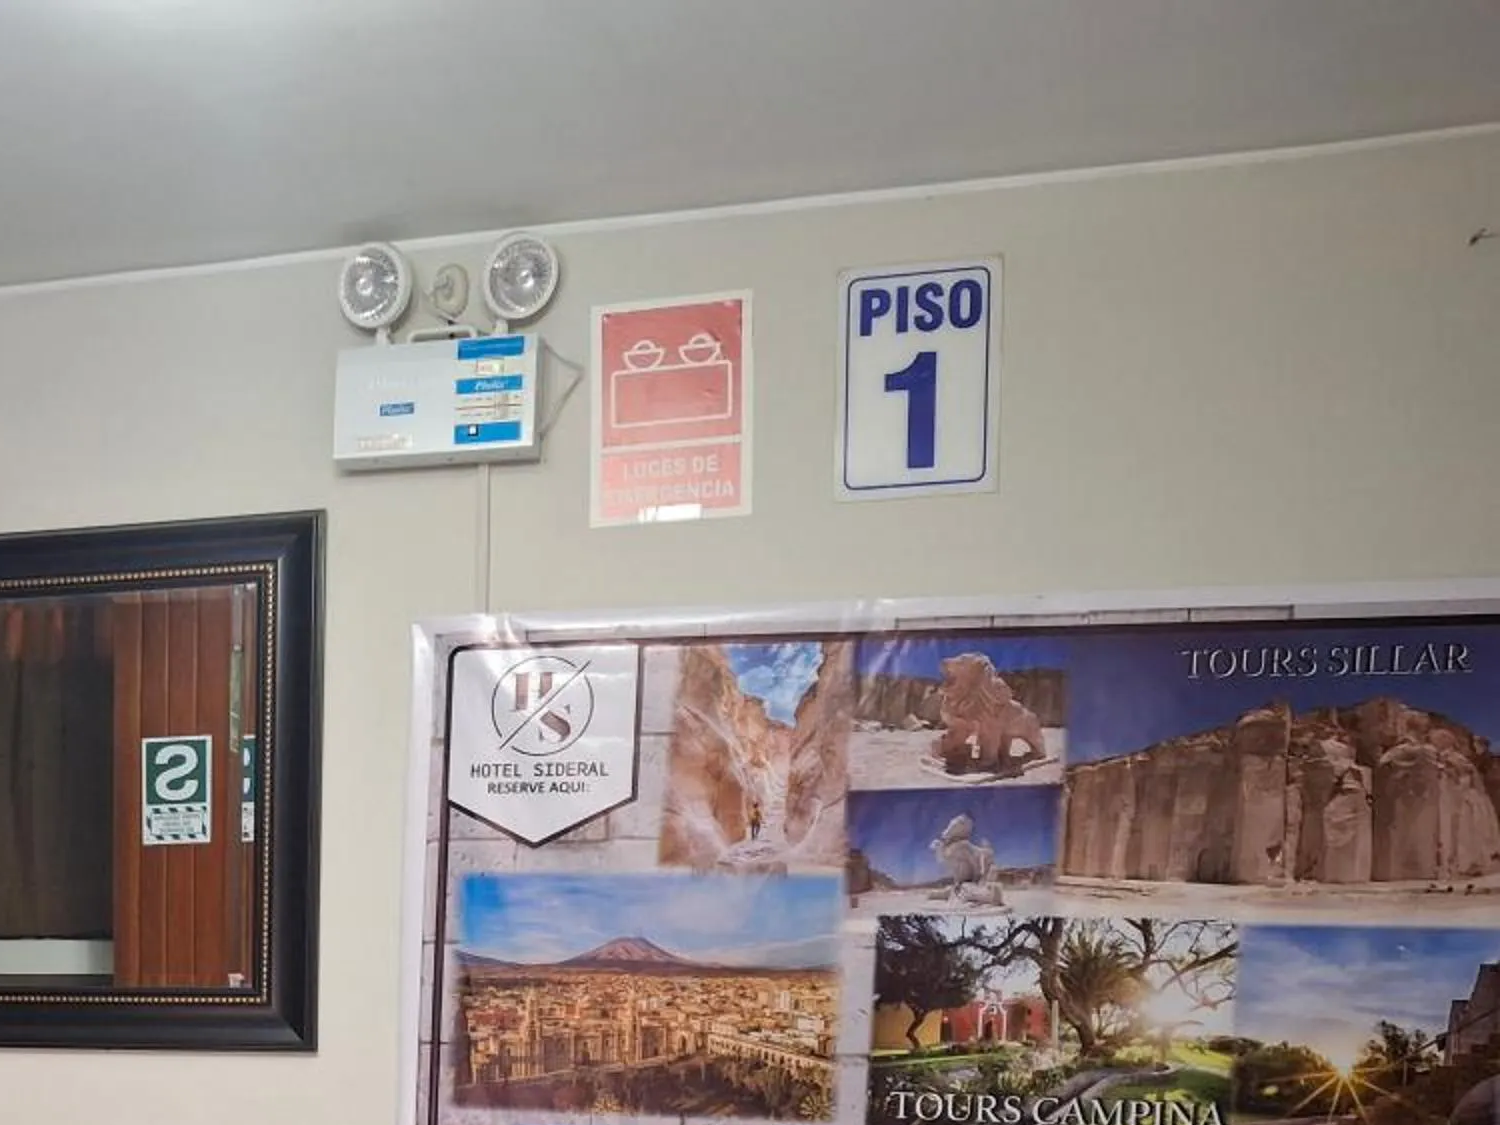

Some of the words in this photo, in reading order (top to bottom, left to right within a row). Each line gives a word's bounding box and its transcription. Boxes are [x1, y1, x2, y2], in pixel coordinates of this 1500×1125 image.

[859, 279, 983, 337] PISO
[883, 351, 938, 469] 1
[622, 456, 687, 481] LUCES
[692, 454, 720, 474] DE
[604, 478, 735, 504] MERGENCIA
[1179, 647, 1318, 679] TOURS
[1327, 643, 1473, 676] SILLAR
[470, 763, 522, 778] HOTEL
[533, 761, 610, 777] SIDERAL
[487, 781, 546, 795] RESERVE
[889, 1090, 1022, 1124] TOURS
